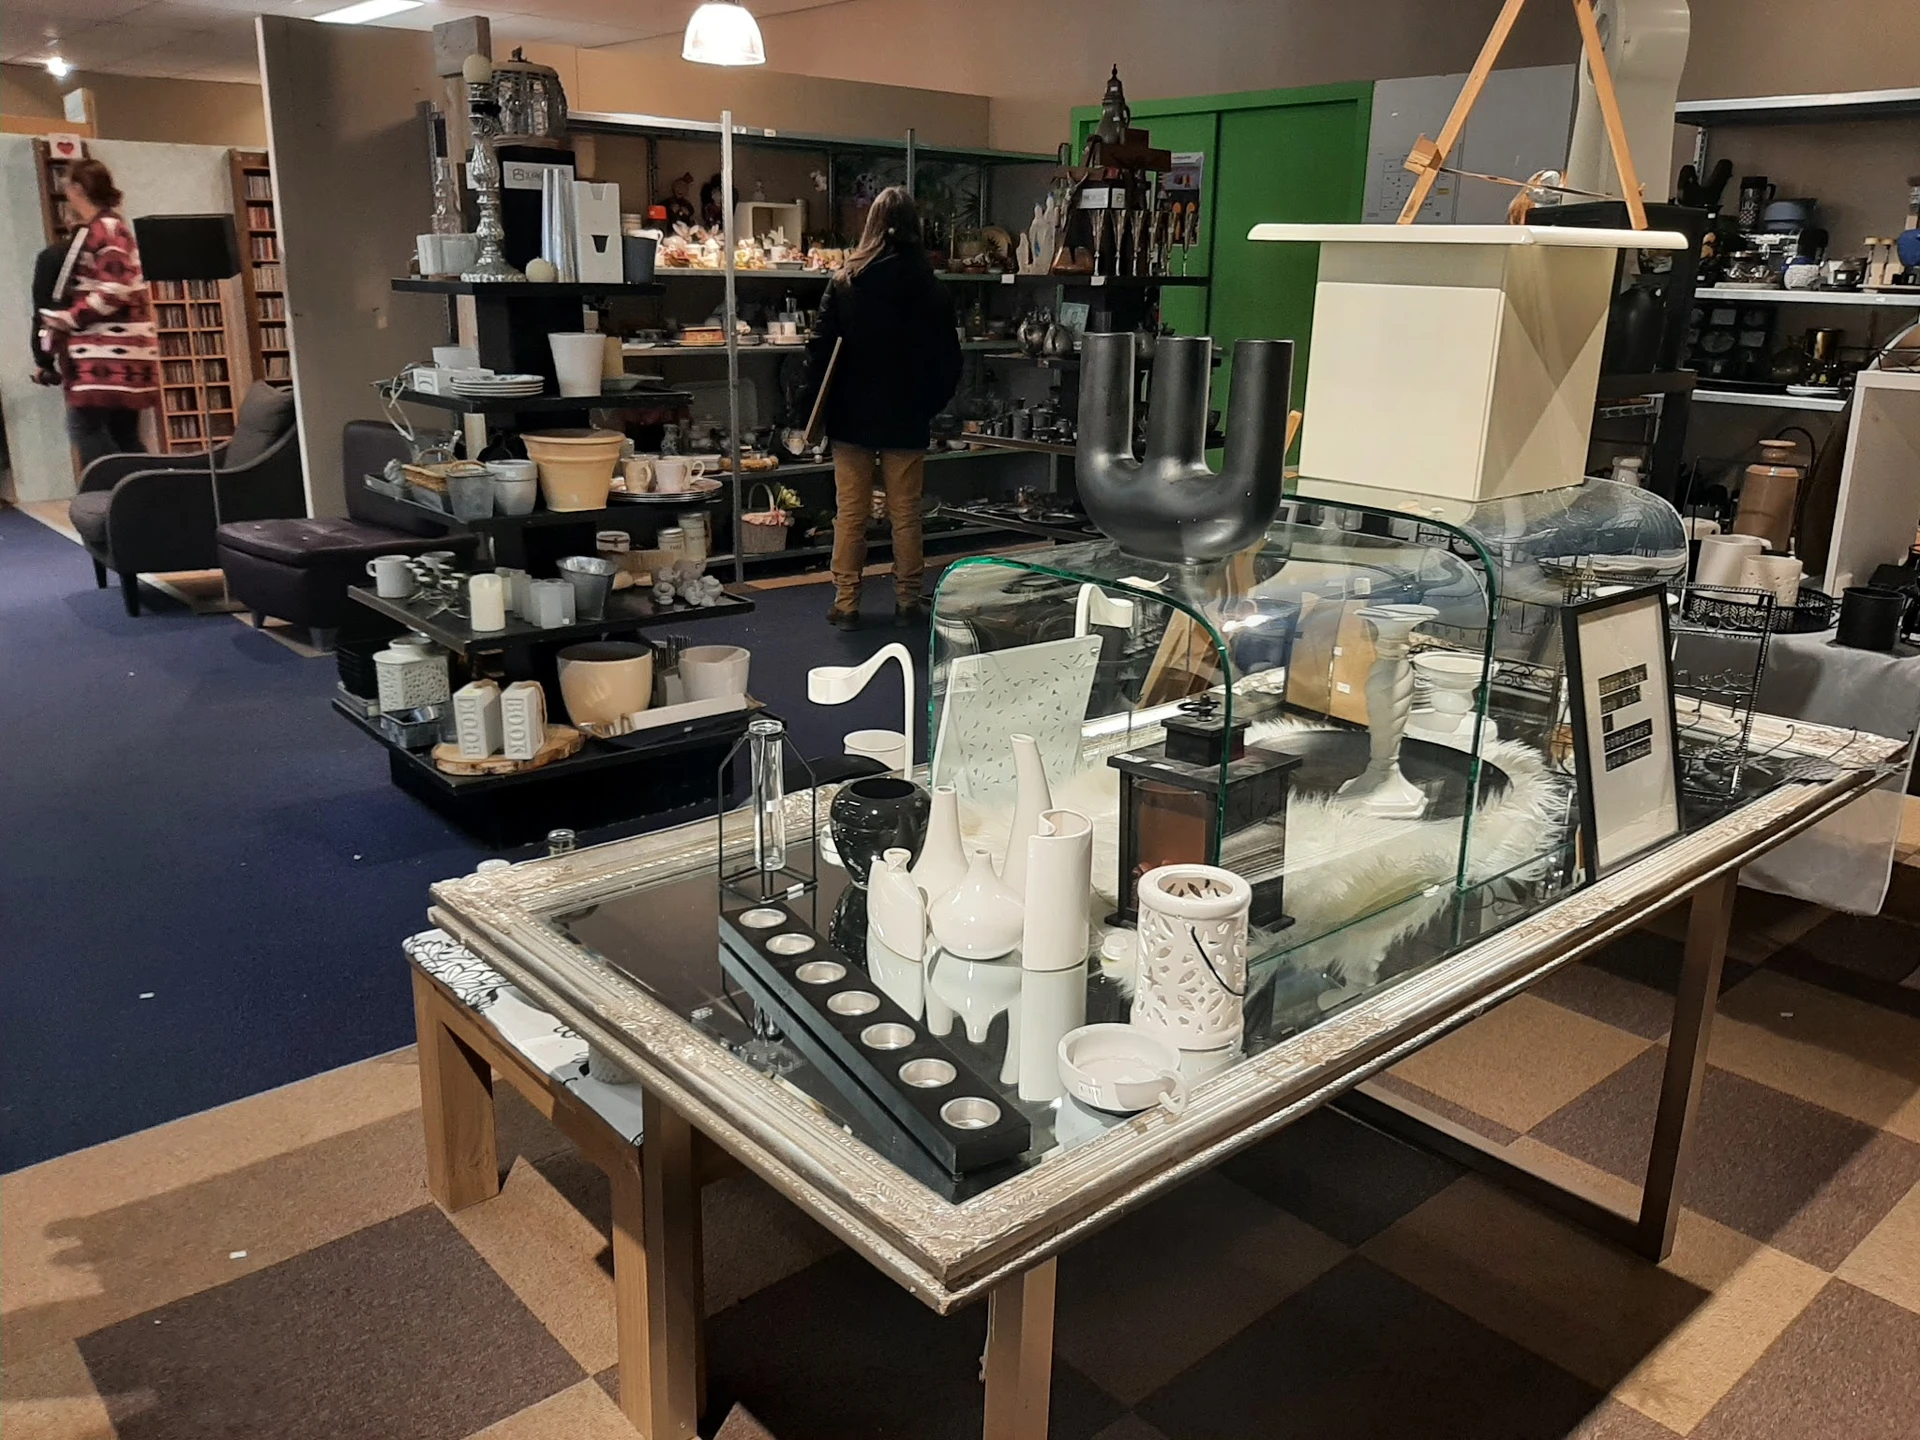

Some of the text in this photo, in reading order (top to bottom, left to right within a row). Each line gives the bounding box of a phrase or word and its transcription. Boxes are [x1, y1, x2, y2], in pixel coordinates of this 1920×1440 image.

[459, 699, 480, 756] BOOK
[505, 699, 526, 756] BOOK
[1605, 724, 1649, 750] sometimes
